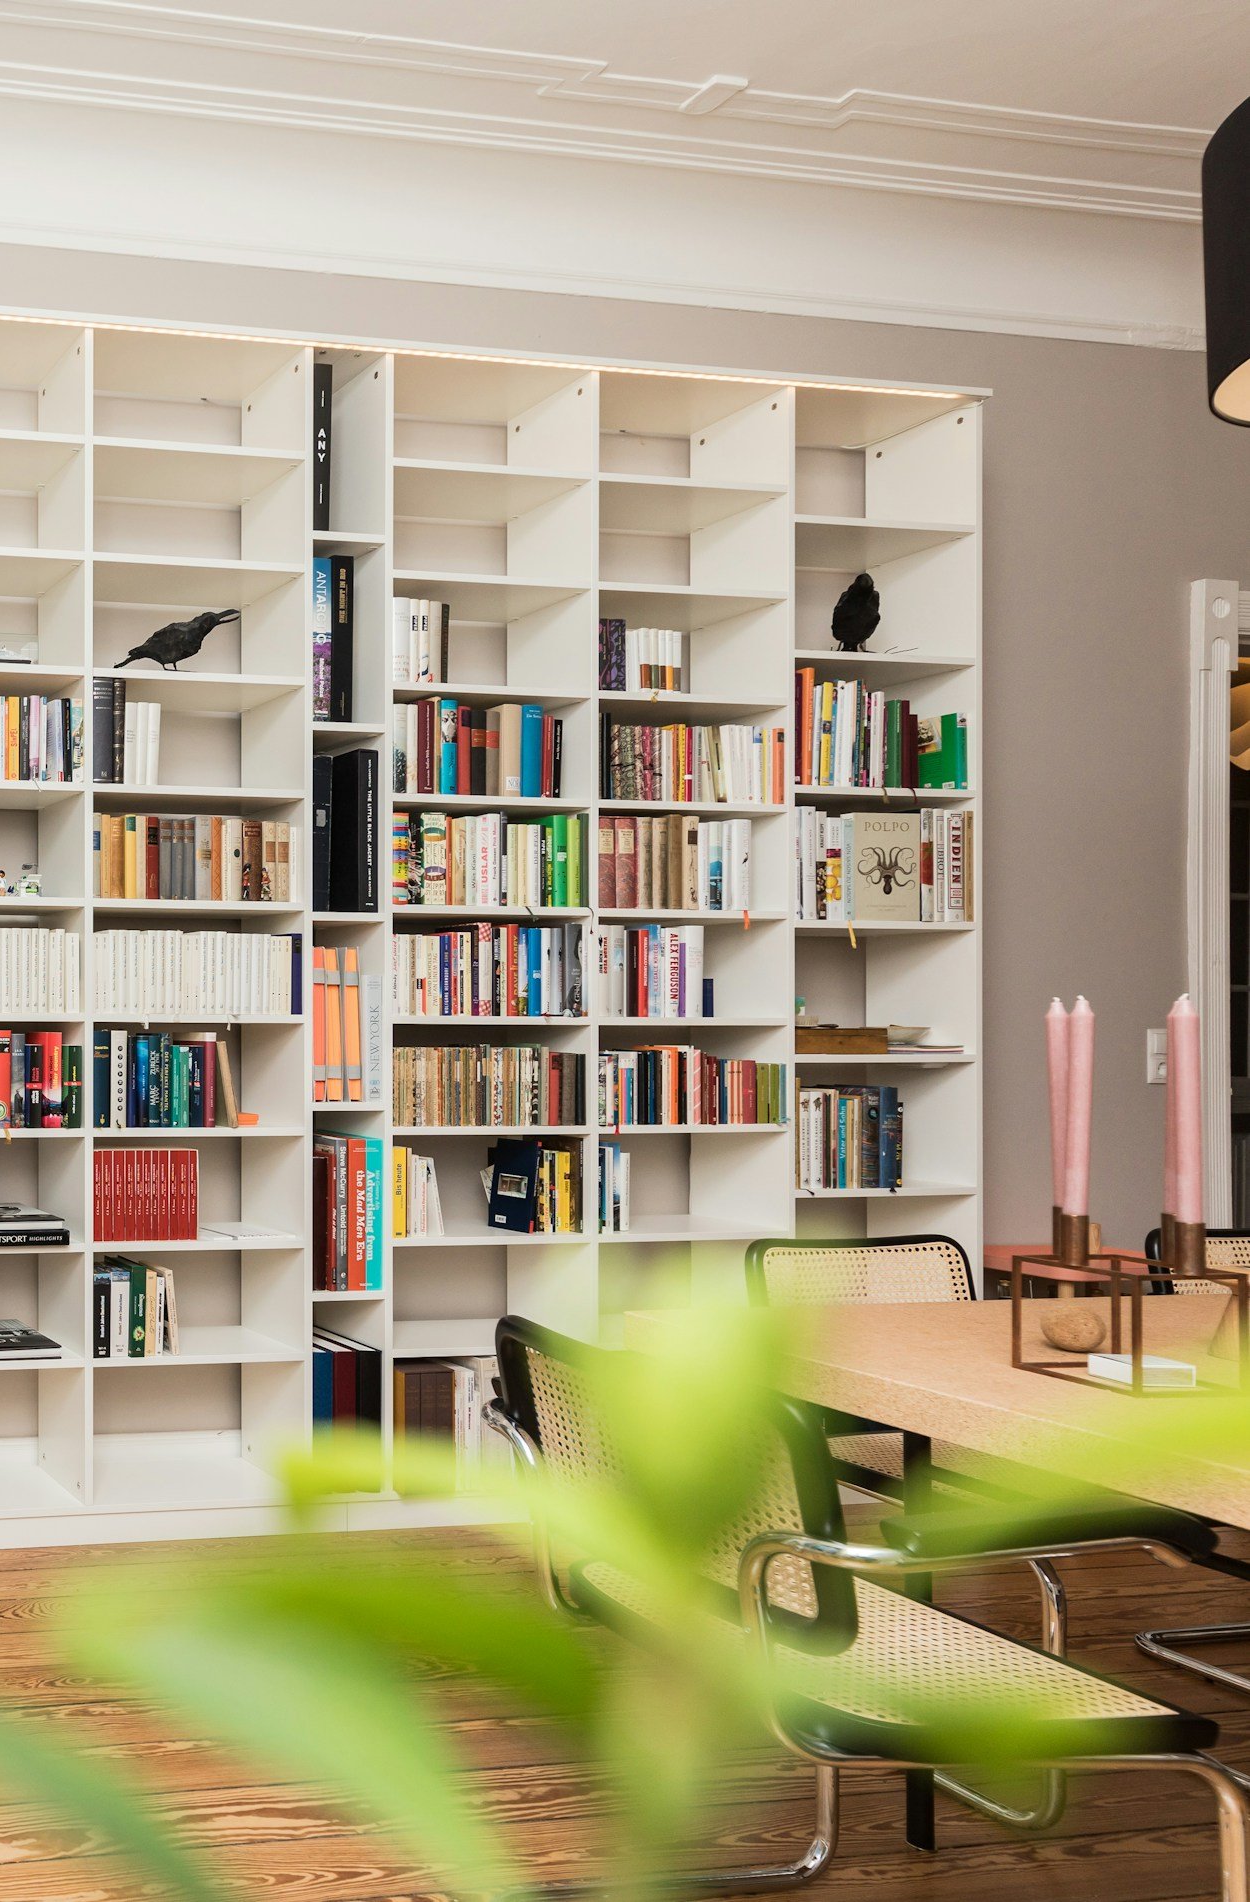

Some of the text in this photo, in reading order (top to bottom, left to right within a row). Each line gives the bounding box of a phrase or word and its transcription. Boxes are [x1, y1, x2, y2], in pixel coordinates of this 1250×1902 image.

[317, 428, 326, 463] ANY
[864, 821, 910, 832] POLPO
[937, 850, 945, 878] BROT
[952, 826, 961, 884] INDIEN
[670, 934, 678, 999] ALEX FERGUSON
[370, 1005, 380, 1072] NEW YORK
[339, 1146, 347, 1166] Steve
[339, 1167, 347, 1199] McCurry
[395, 1164, 403, 1196] Bis heute
[356, 1169, 366, 1261] the Mad Men Era
[365, 1169, 376, 1261] Advertising from
